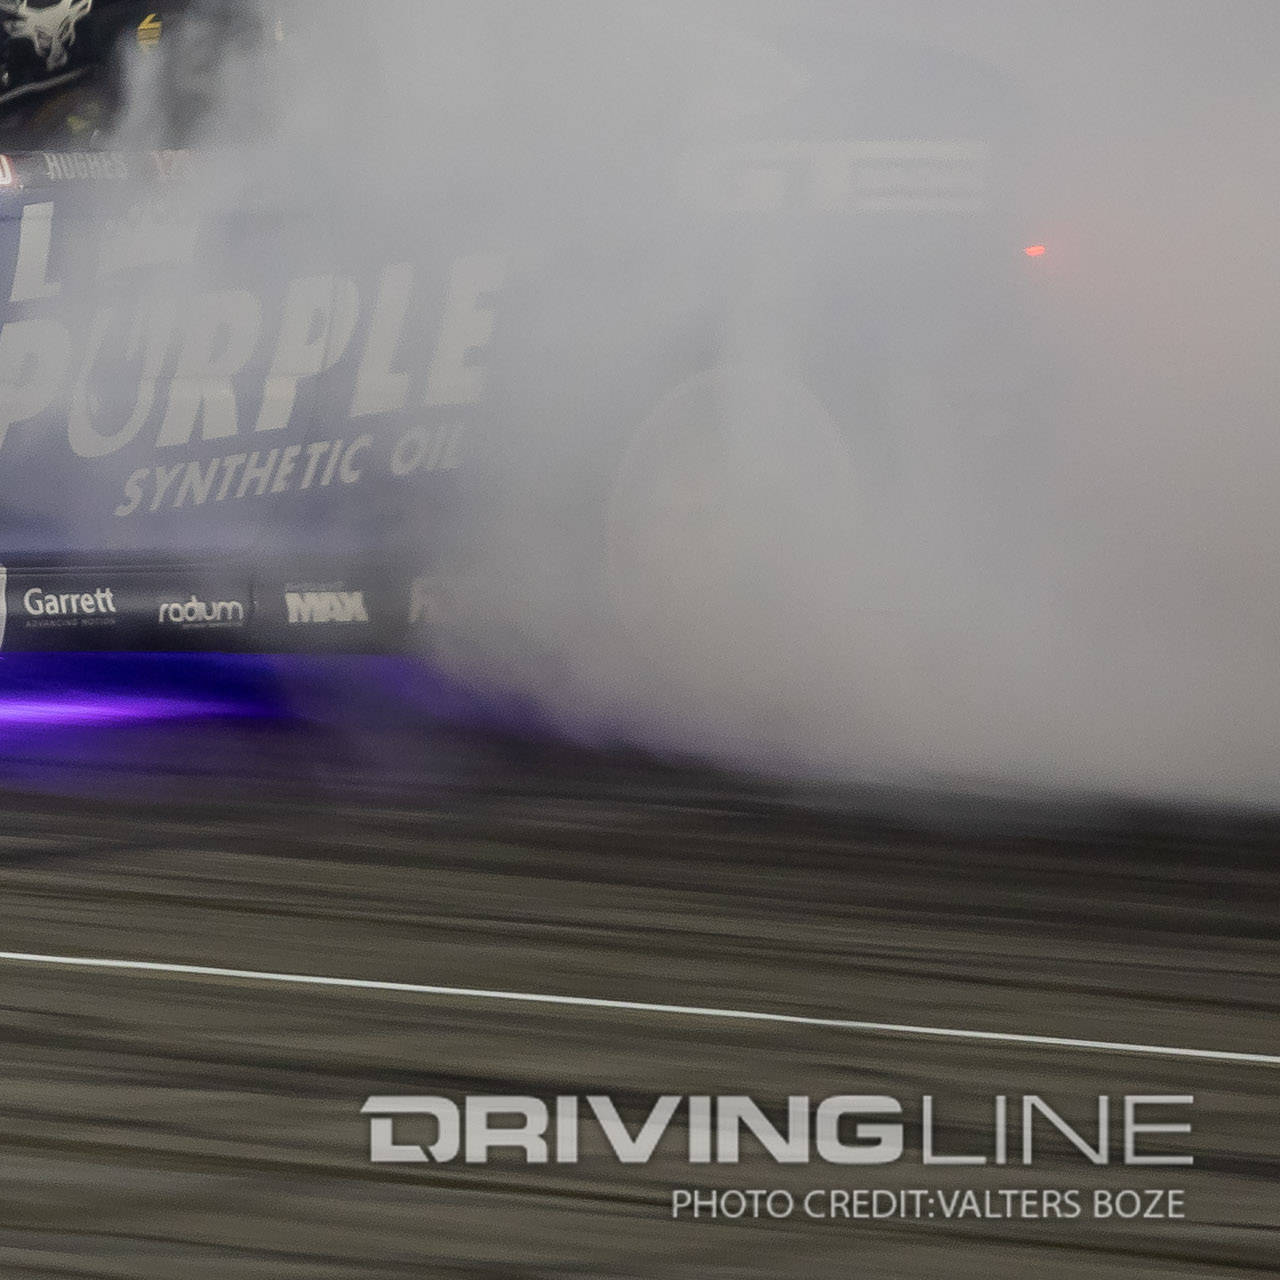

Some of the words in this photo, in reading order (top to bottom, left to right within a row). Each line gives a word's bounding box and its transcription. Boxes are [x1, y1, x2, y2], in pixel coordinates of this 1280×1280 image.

[114, 436, 374, 517] SYNTHETIC
[390, 423, 466, 477] OIL
[23, 587, 117, 616] Garrett
